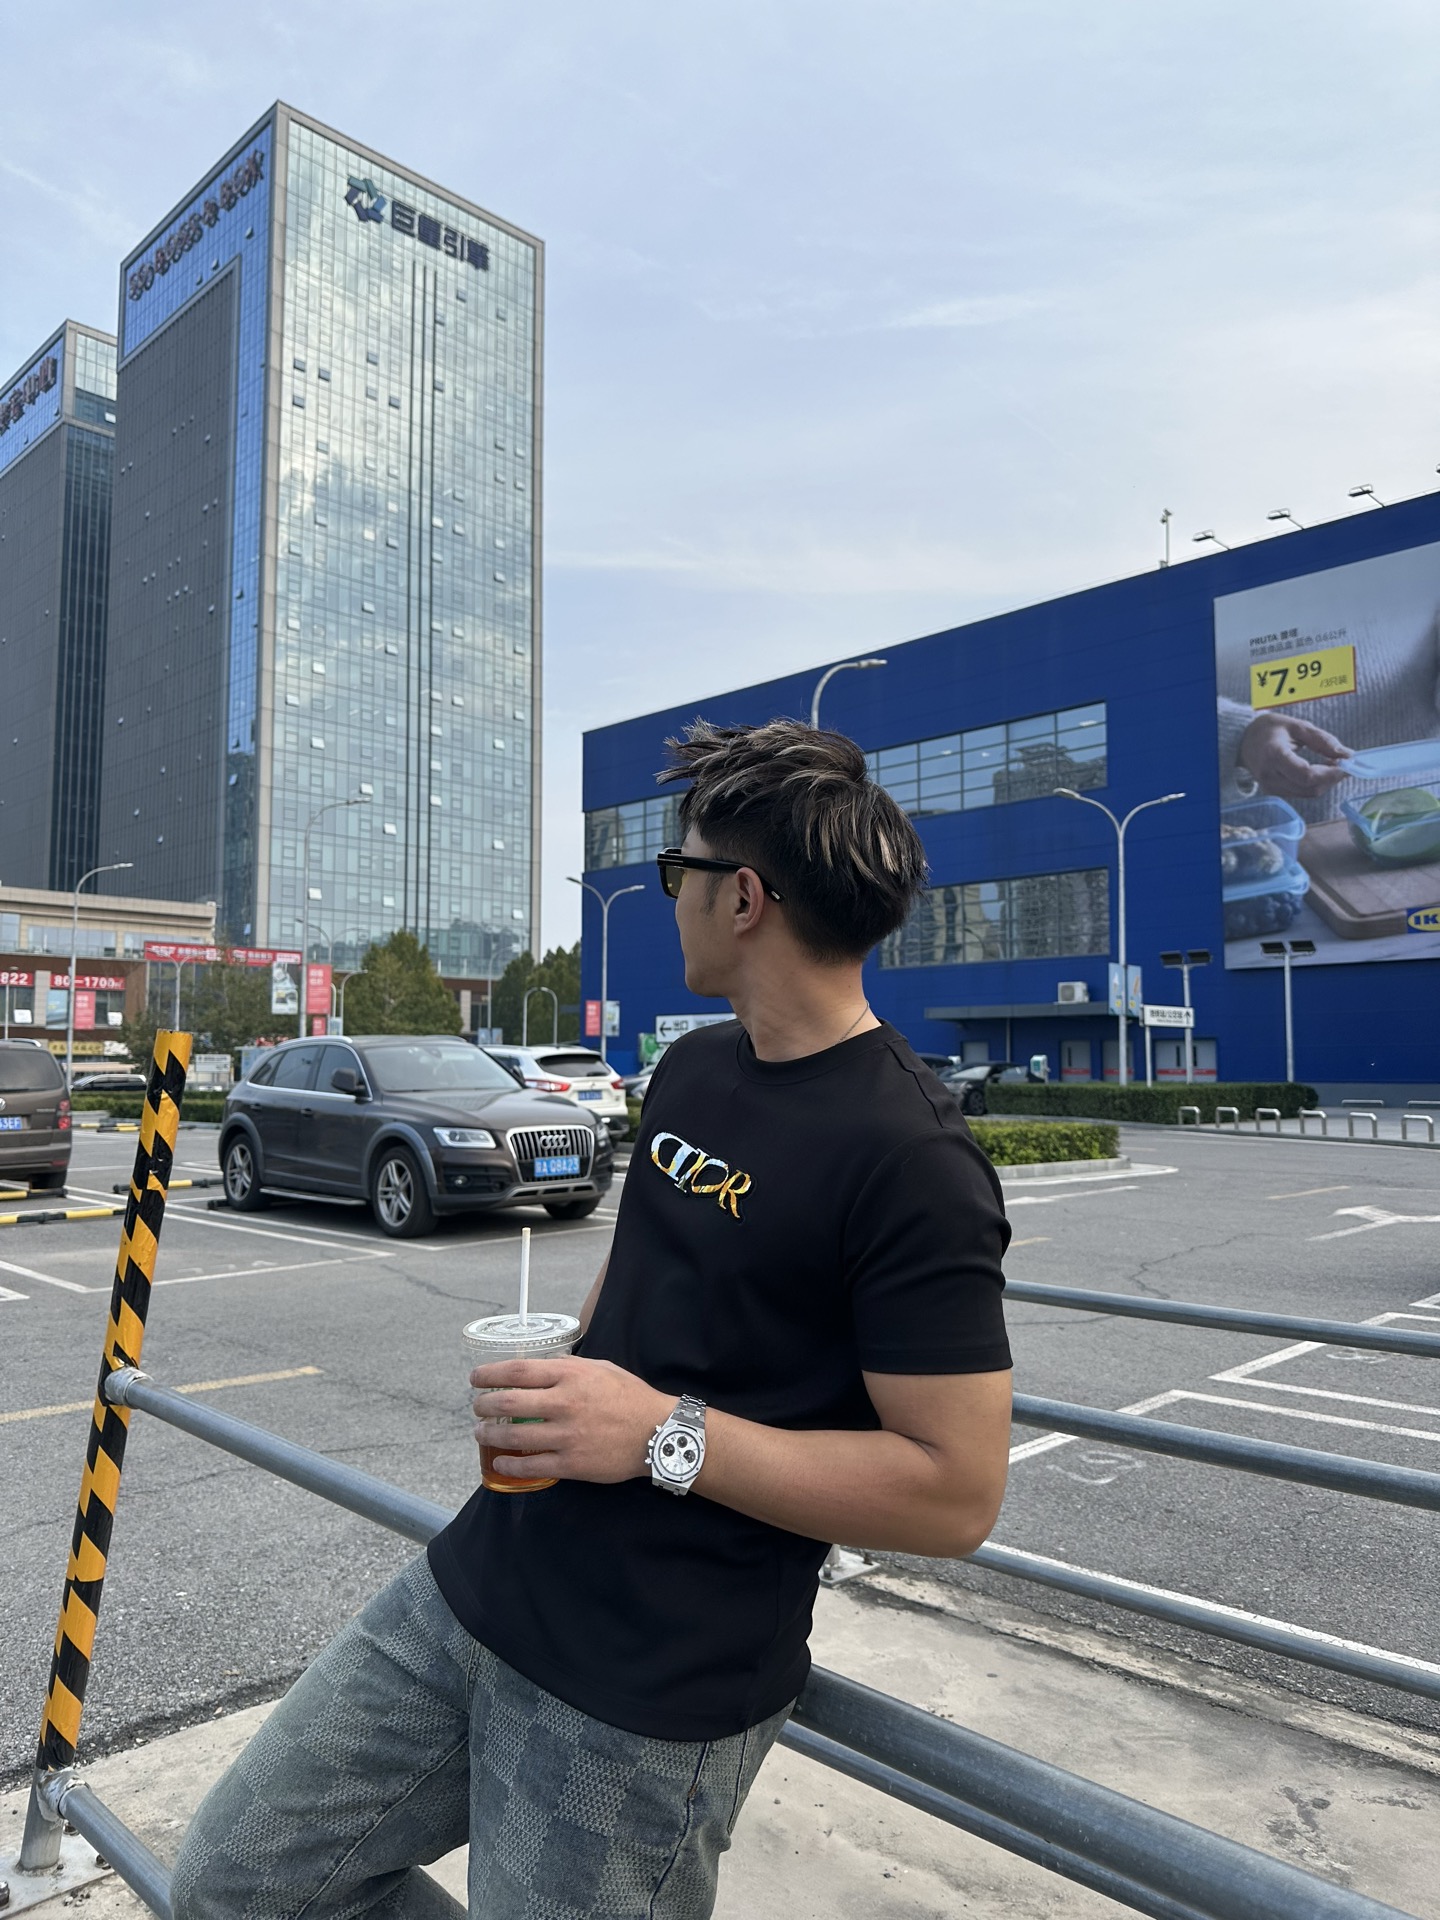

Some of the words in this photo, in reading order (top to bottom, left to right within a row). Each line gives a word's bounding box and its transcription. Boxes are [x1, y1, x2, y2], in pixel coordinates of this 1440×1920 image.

[1249, 633, 1277, 647] PRUTA
[673, 1019, 689, 1031] 出口
[651, 1132, 752, 1218] DIOR
